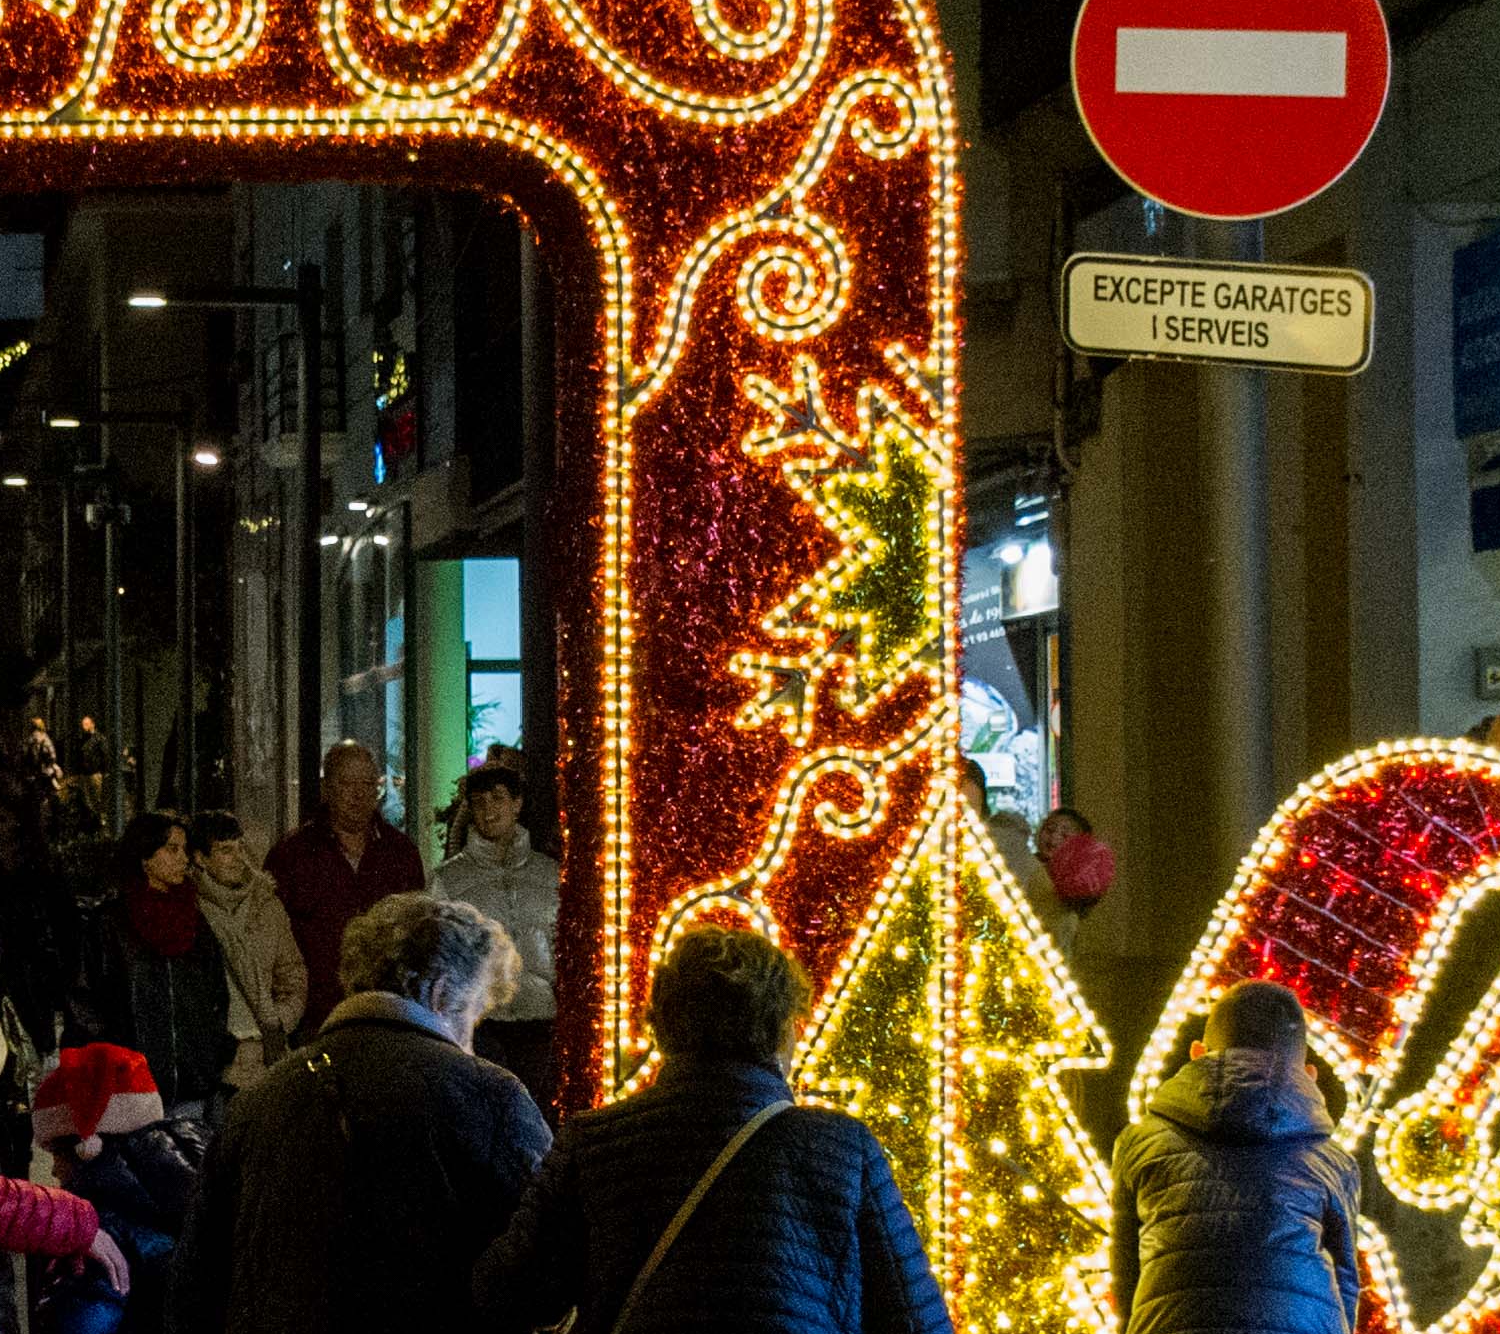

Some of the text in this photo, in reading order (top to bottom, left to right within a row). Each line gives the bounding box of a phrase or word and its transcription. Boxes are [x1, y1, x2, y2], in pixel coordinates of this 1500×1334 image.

[1094, 275, 1352, 317] EXCEPTE GARATGES
[1152, 314, 1270, 348] I SERVEIS
